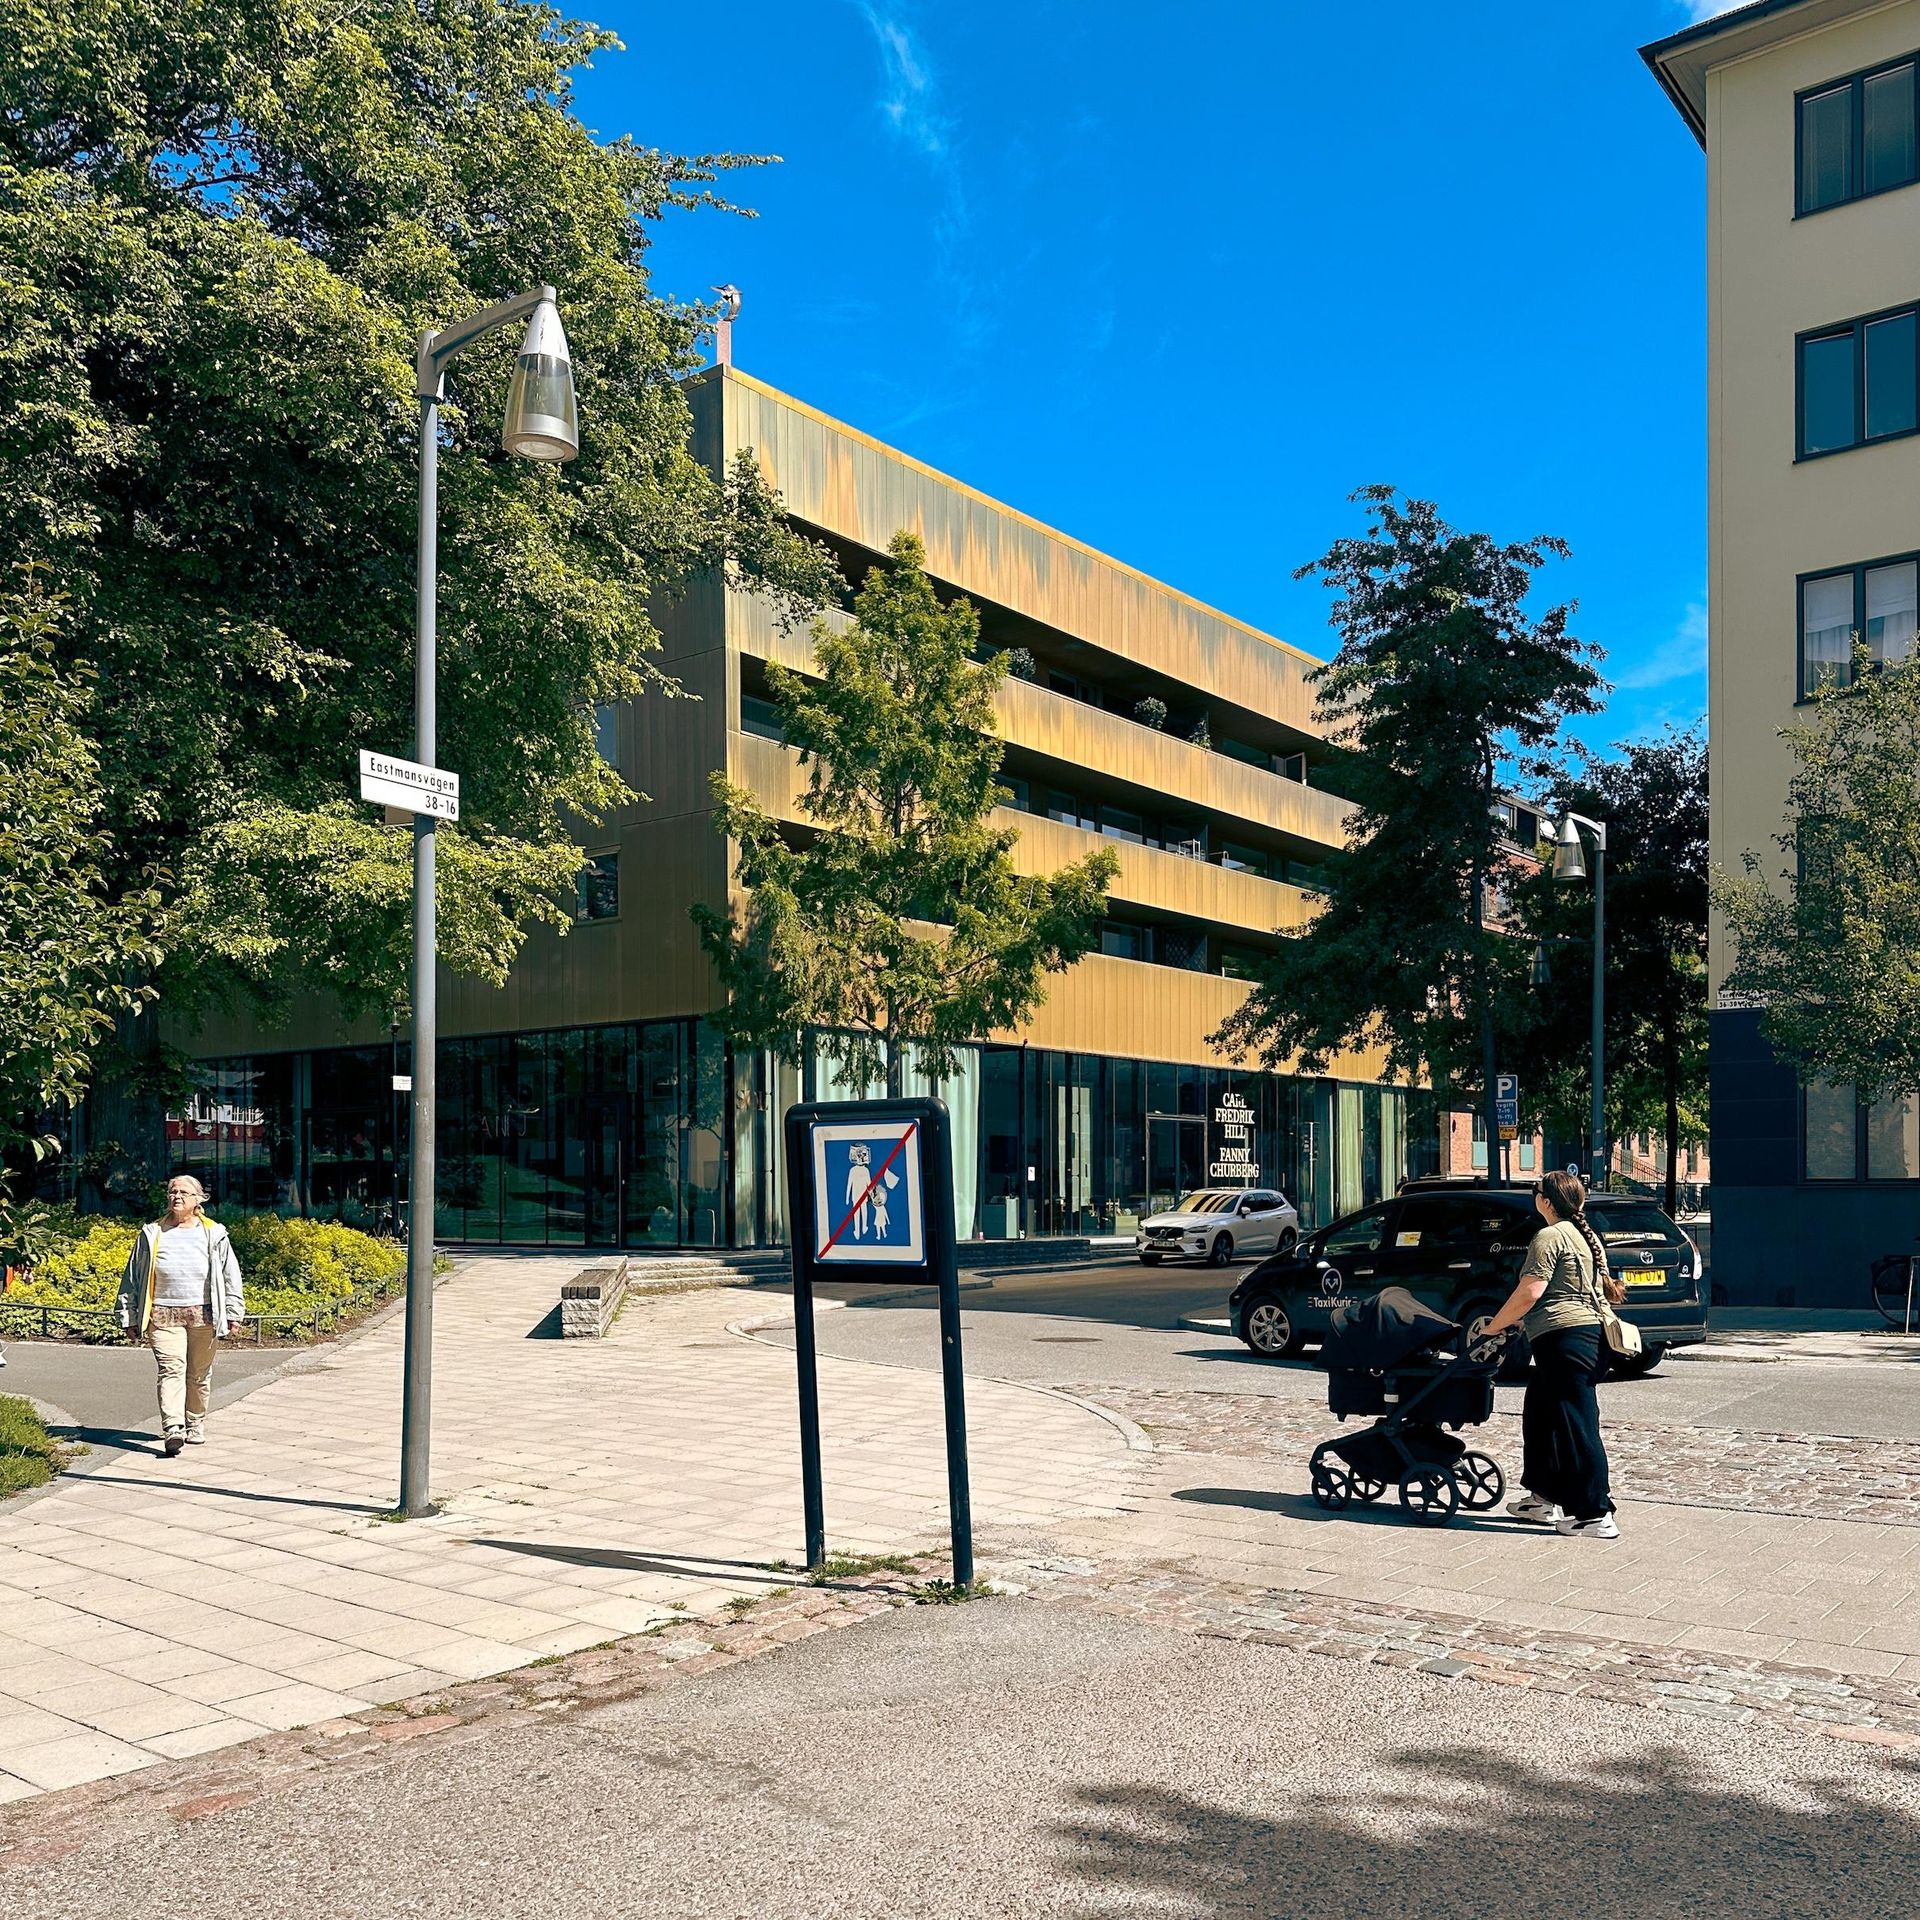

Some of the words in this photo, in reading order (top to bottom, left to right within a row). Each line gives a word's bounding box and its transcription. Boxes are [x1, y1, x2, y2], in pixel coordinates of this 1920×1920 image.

[371, 757, 454, 791] Eastmansvägen
[426, 795, 455, 814] 38-16
[1498, 1078, 1512, 1098] P
[1215, 1108, 1255, 1124] FREDRIK
[1224, 1124, 1246, 1139] HILL
[1220, 1148, 1250, 1163] FANNY
[1210, 1163, 1259, 1178] CHURBERG
[1313, 1296, 1351, 1307] TaxiKurir
